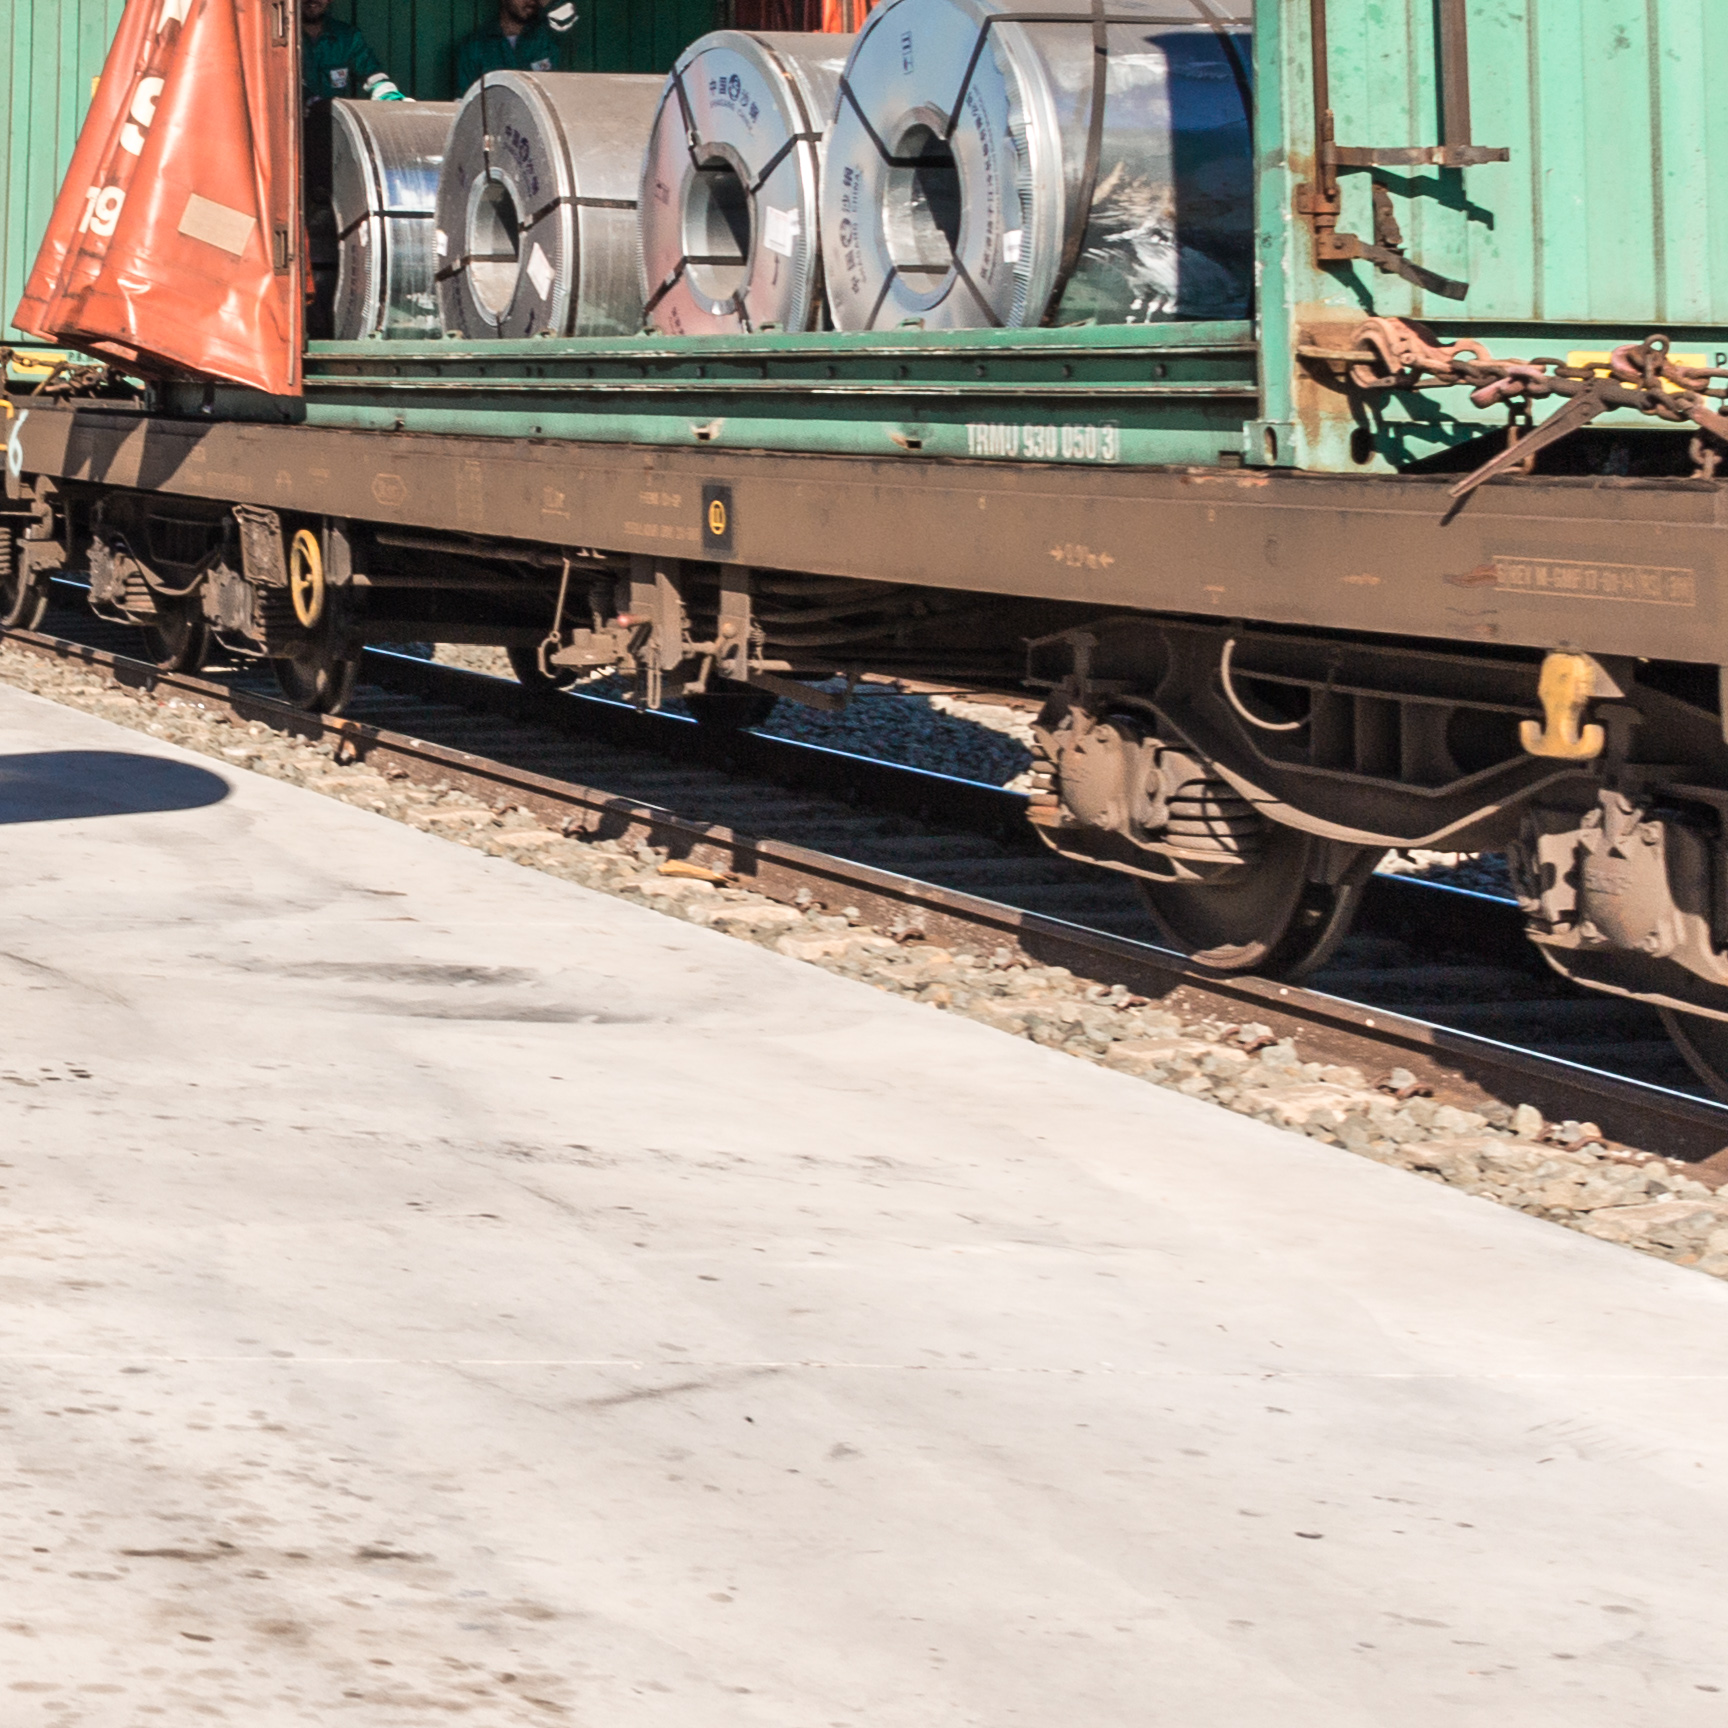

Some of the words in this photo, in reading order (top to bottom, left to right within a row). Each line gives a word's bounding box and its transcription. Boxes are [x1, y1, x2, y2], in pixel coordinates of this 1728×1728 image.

[965, 421, 1019, 457] TRMU
[1023, 423, 1058, 458] 930
[1061, 423, 1097, 459] 050
[1101, 424, 1115, 460] 3
